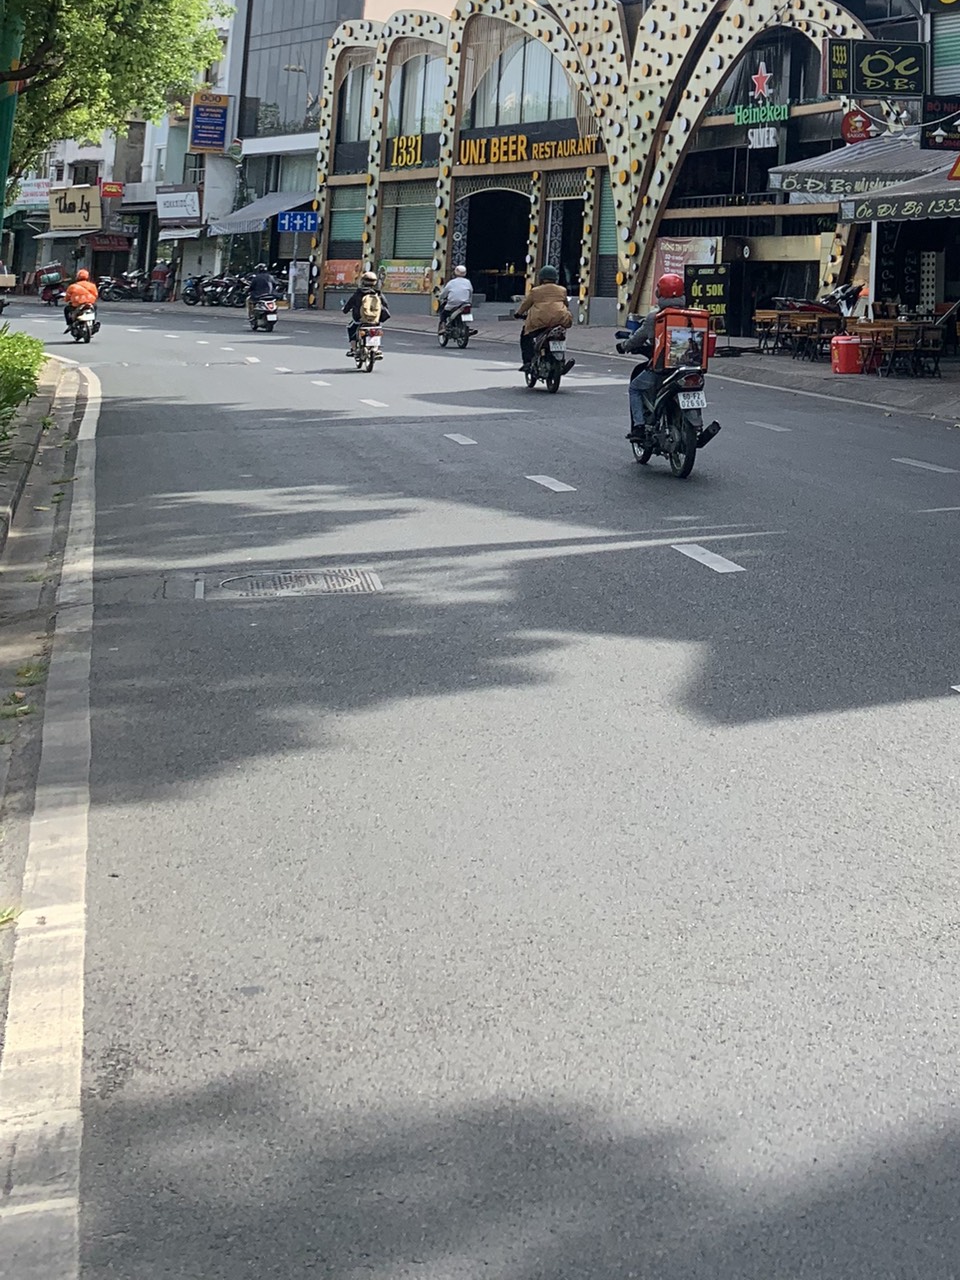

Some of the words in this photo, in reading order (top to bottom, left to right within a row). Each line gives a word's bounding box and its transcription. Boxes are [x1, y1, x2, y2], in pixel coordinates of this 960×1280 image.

[833, 45, 847, 64] 1333
[734, 99, 789, 126] Heineken
[748, 127, 778, 149] SILVER
[390, 135, 423, 166] 1331
[460, 138, 487, 166] UNI
[490, 135, 528, 163] BEER
[532, 136, 599, 160] RESTAURANT
[855, 200, 873, 219] Ốc
[877, 203, 897, 217] Đi
[901, 201, 925, 218] Bộ
[692, 280, 703, 296] ỐC
[706, 283, 724, 297] 50K
